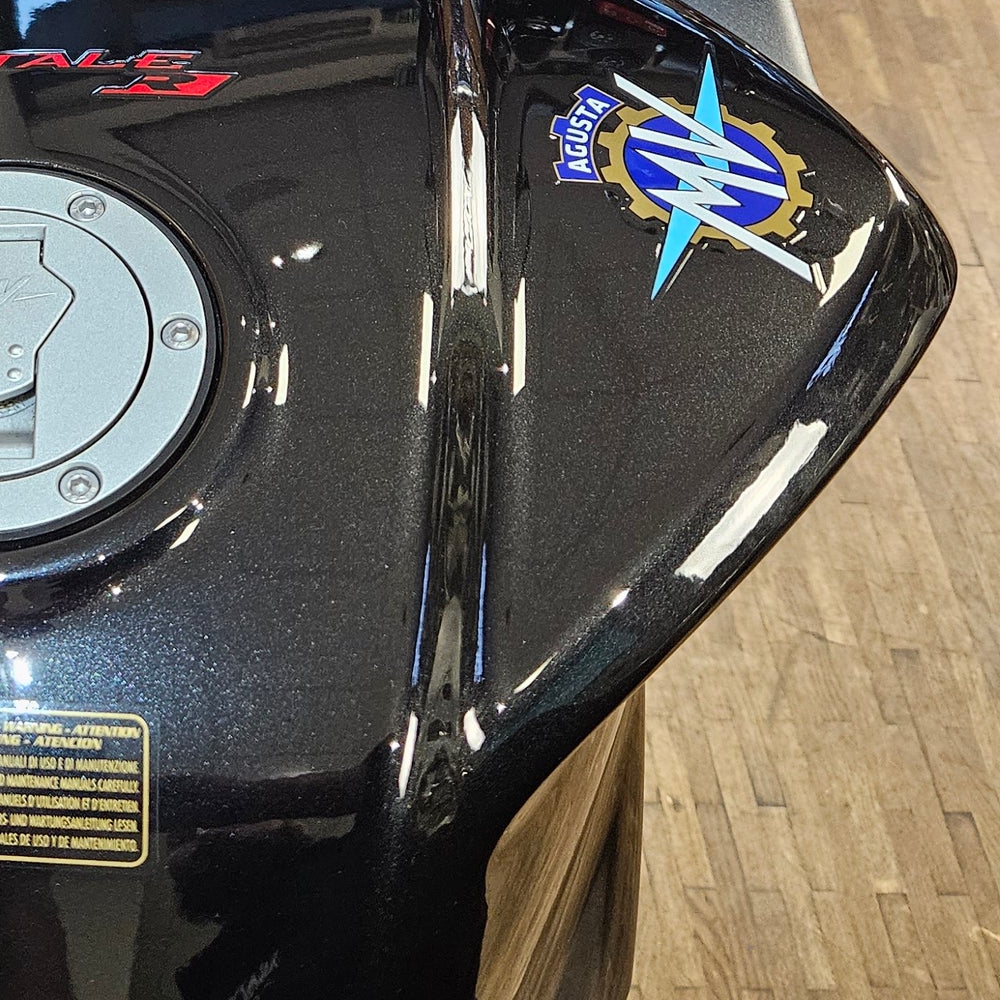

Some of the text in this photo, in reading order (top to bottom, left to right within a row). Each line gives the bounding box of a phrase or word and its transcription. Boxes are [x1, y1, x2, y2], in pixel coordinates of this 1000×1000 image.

[565, 97, 611, 174] AGUSTA
[3, 720, 63, 735] WARNING
[71, 724, 141, 739] ATTENTION
[33, 735, 103, 751] ATENCION
[27, 755, 39, 769] DI
[39, 756, 57, 770] USO
[57, 757, 65, 770] E
[6, 773, 60, 790] MAINTENANCE
[60, 777, 98, 791] MANUALS
[81, 797, 91, 811] ET
[9, 813, 28, 827] UND
[19, 833, 32, 846] DE
[32, 834, 50, 847] USO
[57, 836, 71, 849] DE
